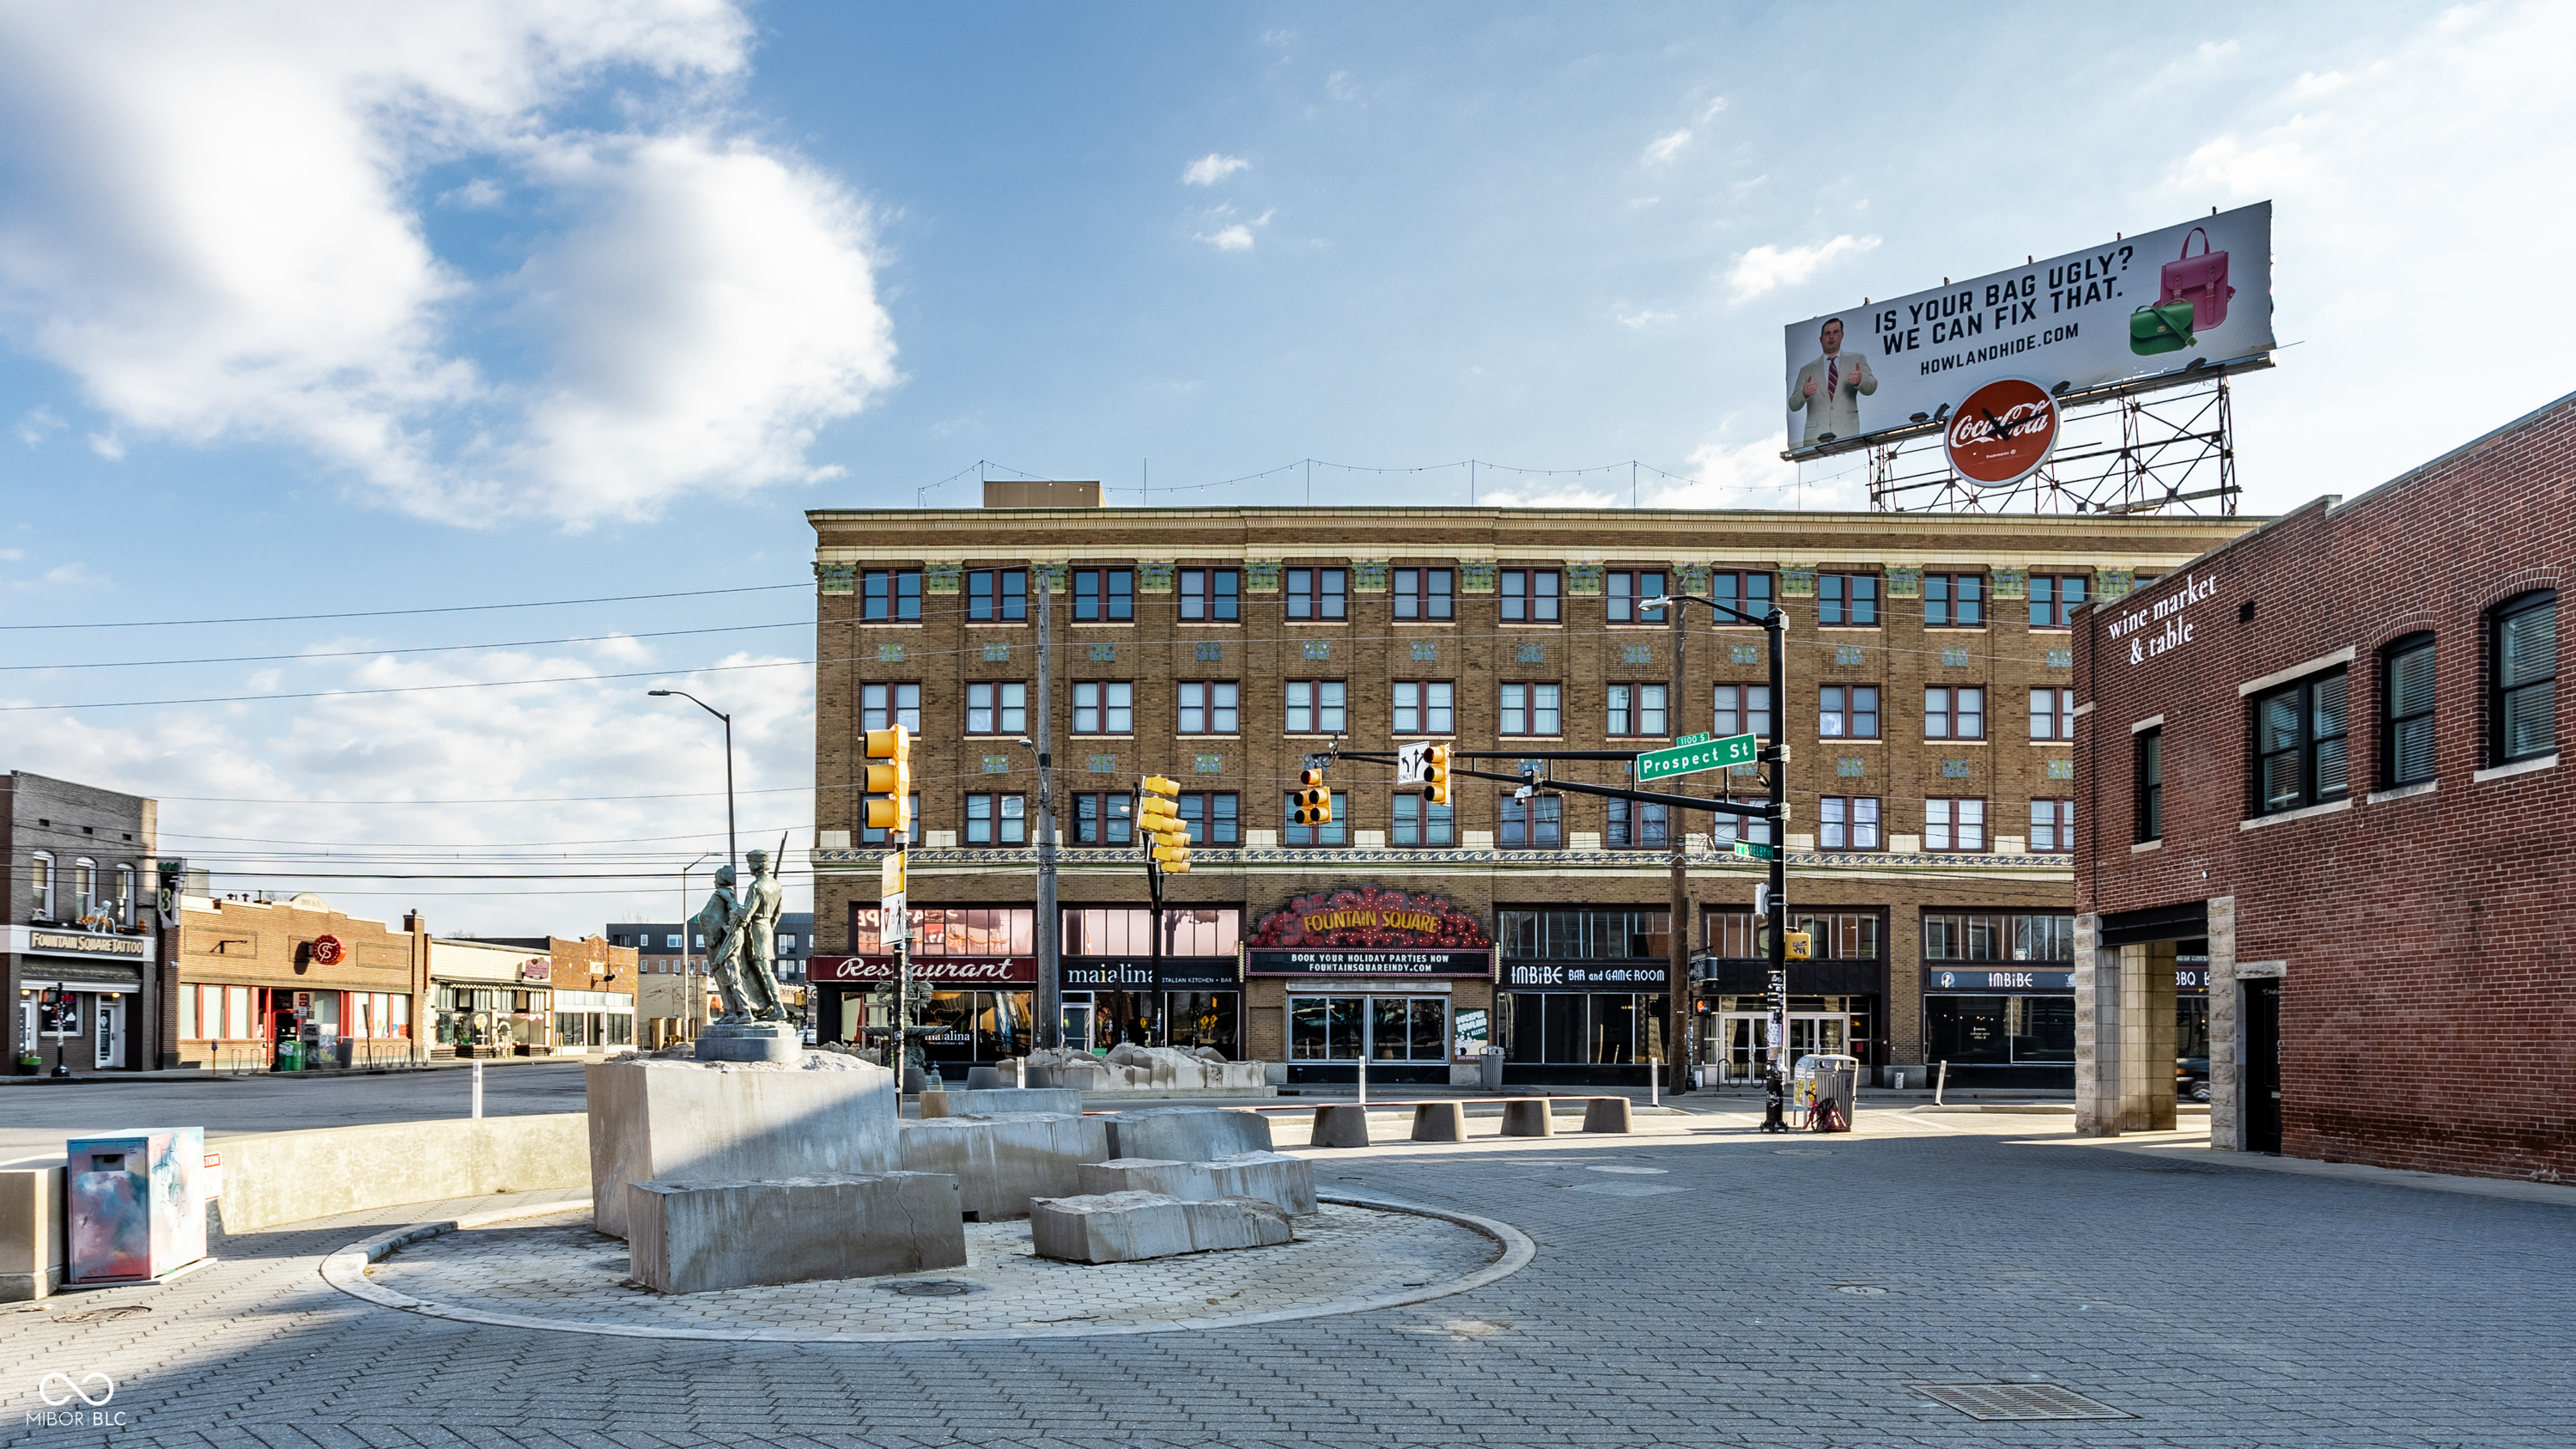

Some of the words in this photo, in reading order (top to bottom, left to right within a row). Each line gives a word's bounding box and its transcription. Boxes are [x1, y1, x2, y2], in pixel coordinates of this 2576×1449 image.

[1875, 310, 1897, 334] IS
[1908, 291, 1973, 326] YOUR
[1985, 275, 2036, 307] BAG
[2049, 246, 2134, 289] UGLY?
[1883, 327, 1920, 356] WE
[1933, 313, 1982, 344] CAN
[1995, 298, 2037, 330] FIX
[2050, 277, 2123, 314] THAT.
[1920, 322, 2079, 376] HOWLANDHIDE.COM
[2108, 610, 2148, 640] wine
[2154, 574, 2217, 621] market
[2130, 637, 2144, 665] &
[2149, 615, 2194, 657] table
[1680, 735, 1698, 746] 1100
[1643, 747, 1718, 773] Prospect
[1730, 742, 1749, 758] St
[1747, 843, 1767, 858] SHELBY
[1303, 910, 1376, 933] FOUNTAIN
[1382, 910, 1439, 934] SQUARE
[32, 932, 78, 949] FOUNTAIN
[78, 935, 112, 952] SQUARE
[112, 939, 143, 953] TATTOO
[836, 957, 1013, 979] Resaurant
[1291, 953, 1315, 962] BOOK
[1389, 954, 1427, 963] PARTIES
[1431, 954, 1449, 963] NOW
[1309, 964, 1432, 972] FOUNTAINSQUAREINDY.COM
[1568, 969, 1585, 981] BAR
[1589, 970, 1603, 981] and
[1605, 969, 1632, 981] GAME
[1634, 969, 1665, 982] ROOM
[1457, 1018, 1487, 1032] BOWLING
[1471, 1027, 1486, 1036] ALLEYS
